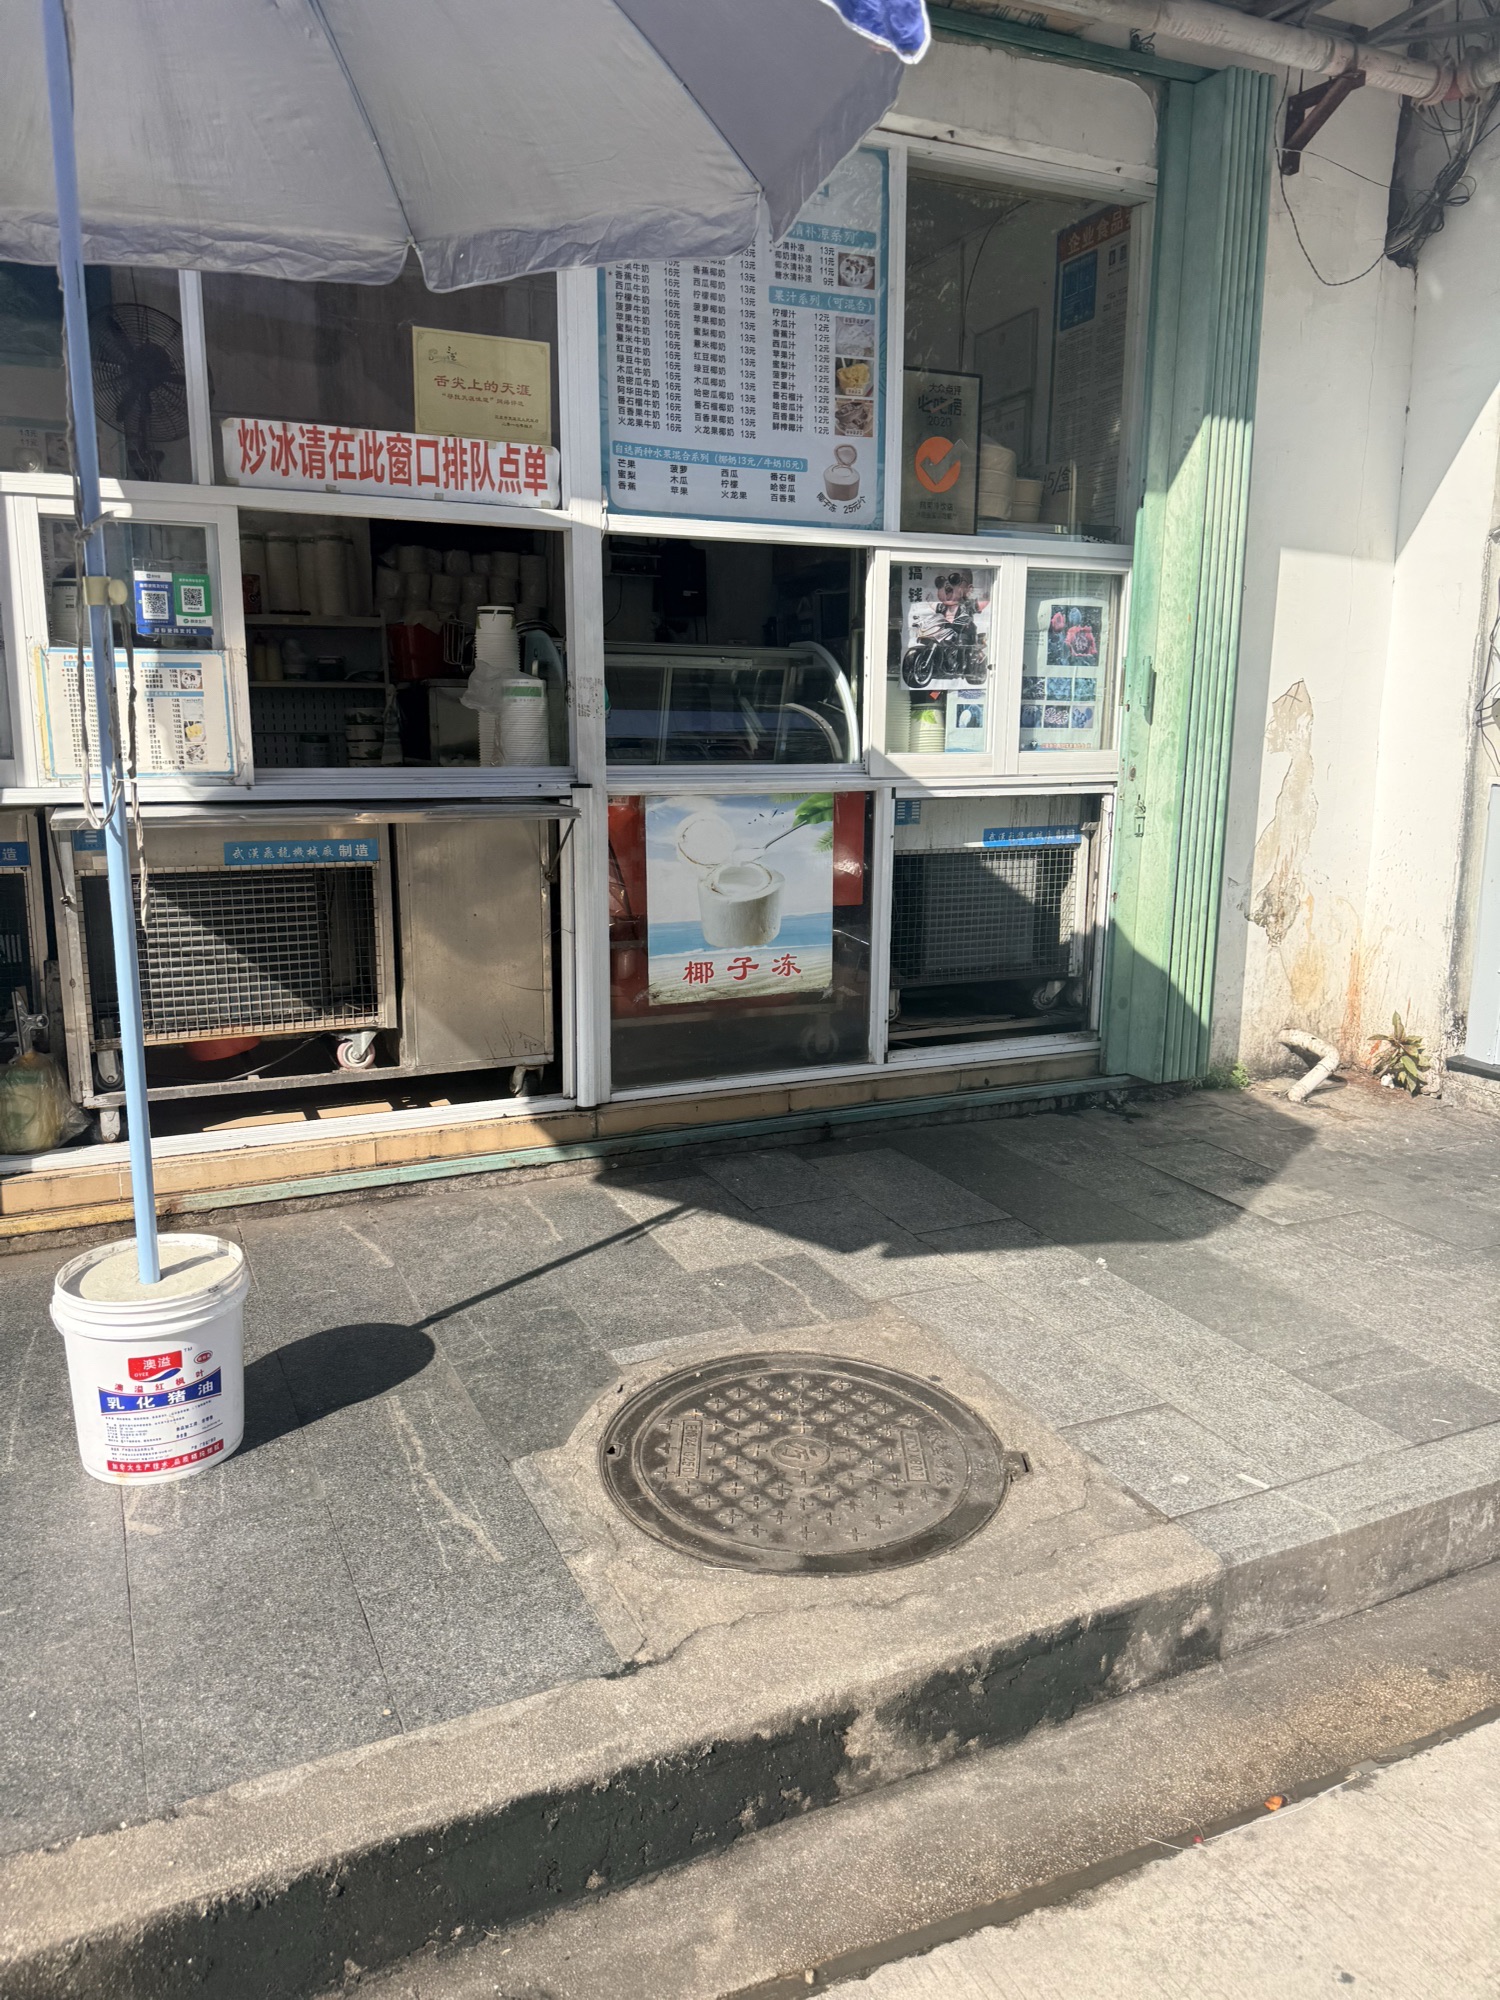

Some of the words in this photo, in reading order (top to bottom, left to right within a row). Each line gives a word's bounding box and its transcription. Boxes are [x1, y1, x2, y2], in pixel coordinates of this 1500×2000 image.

[777, 242, 805, 252] 清补凉
[820, 247, 834, 256] 13元
[740, 260, 756, 270] 13元
[775, 251, 812, 263] 椰奶清补凉
[820, 257, 834, 266] 11元
[664, 268, 680, 277] 16元
[693, 265, 726, 278] 香蕉椰奶
[740, 273, 756, 282] 13元
[775, 261, 812, 274] 椰水清补凉
[820, 267, 834, 276] 11元
[615, 270, 650, 283] 香蕉牛奶
[664, 278, 680, 288] 16元
[693, 278, 726, 290] 西瓜椰奶
[740, 285, 756, 294] 13元
[823, 278, 834, 286] 9元
[615, 281, 650, 294] 西瓜牛奶
[664, 289, 680, 298] 16元
[615, 292, 650, 305] 柠檬牛奶
[664, 300, 680, 309] 16元
[693, 290, 726, 302] 柠檬椰奶
[740, 297, 756, 307] 13元
[615, 302, 650, 315] 菠萝牛奶
[664, 310, 680, 319] 16元
[693, 302, 726, 315] 菠萝椰奶
[740, 310, 756, 319] 13元
[815, 313, 830, 322] 12元
[616, 312, 650, 326] 苹果牛奶
[664, 320, 680, 329] 16元
[693, 315, 726, 327] 苹果椰奶
[740, 322, 756, 331] 13元
[814, 324, 829, 332] 12元
[616, 323, 650, 336] 蜜梨牛奶
[664, 331, 680, 340] 16元
[693, 327, 726, 339] 蜜梨椰奶
[740, 334, 756, 343] 13元
[814, 334, 829, 343] 12元
[616, 333, 650, 346] 薏米牛奶
[665, 341, 682, 350] 16元
[694, 340, 726, 351] 薏米椰奶
[740, 346, 756, 355] 13元
[814, 344, 829, 353] 12元
[616, 344, 650, 356] 红豆牛奶
[665, 351, 682, 360] 16元
[694, 352, 726, 364] 红豆椰奶
[740, 358, 756, 368] 13元
[814, 355, 829, 363] 12元
[616, 354, 651, 367] 绿豆牛奶
[665, 362, 682, 371] 16元
[814, 365, 829, 373] 12元
[616, 365, 651, 377] 木瓜牛奶
[665, 372, 682, 381] 16元
[694, 364, 726, 376] 绿豆椰奶
[740, 370, 756, 380] 13元
[814, 375, 829, 384] 12元
[434, 375, 532, 397] 舌尖上的天涯
[617, 375, 660, 388] 哈密瓜牛奶
[665, 382, 682, 391] 16元
[694, 376, 726, 388] 木瓜椰奶
[740, 382, 756, 392] 13元
[814, 385, 829, 394] 12元
[617, 385, 660, 399] 阿华田牛奶
[665, 392, 682, 402] 16元
[694, 389, 734, 400] 哈密瓜椰奶
[740, 394, 756, 404] 13元
[814, 396, 829, 404] 12元
[618, 396, 660, 409] 番石榴牛奶
[665, 403, 682, 412] 16元
[694, 401, 734, 412] 番石榴椰奶
[740, 406, 756, 416] 13元
[814, 406, 829, 414] 12元
[618, 406, 660, 420] 百香果牛奶
[665, 413, 682, 422] 16元
[694, 413, 734, 424] 百香果椰奶
[740, 418, 756, 428] 13元
[814, 416, 829, 424] 12元
[927, 415, 953, 427] 2020
[618, 416, 660, 430] 火龙果牛奶
[665, 423, 682, 432] 16元
[814, 426, 829, 435] 12元
[694, 425, 735, 437] 火龙果椰奶
[740, 430, 756, 440] 13元
[237, 419, 548, 497] 炒冰请在此窗口排队点单
[618, 459, 636, 468] 芒果
[670, 465, 688, 474] 菠萝
[721, 469, 738, 478] 西瓜
[770, 473, 796, 483] 番石榴
[618, 470, 636, 480] 蜜梨
[670, 476, 688, 485] 木瓜
[721, 480, 739, 489] 柠檬
[770, 483, 796, 493] 哈密瓜
[618, 481, 636, 491] 香蕉
[670, 486, 689, 496] 苹果
[721, 490, 748, 500] 火龙果
[770, 493, 796, 503] 百香果
[2, 847, 18, 861] 造
[682, 953, 802, 985] 椰子冻
[143, 1356, 172, 1371] 澳溢
[107, 1380, 214, 1410] 乳化猪油
